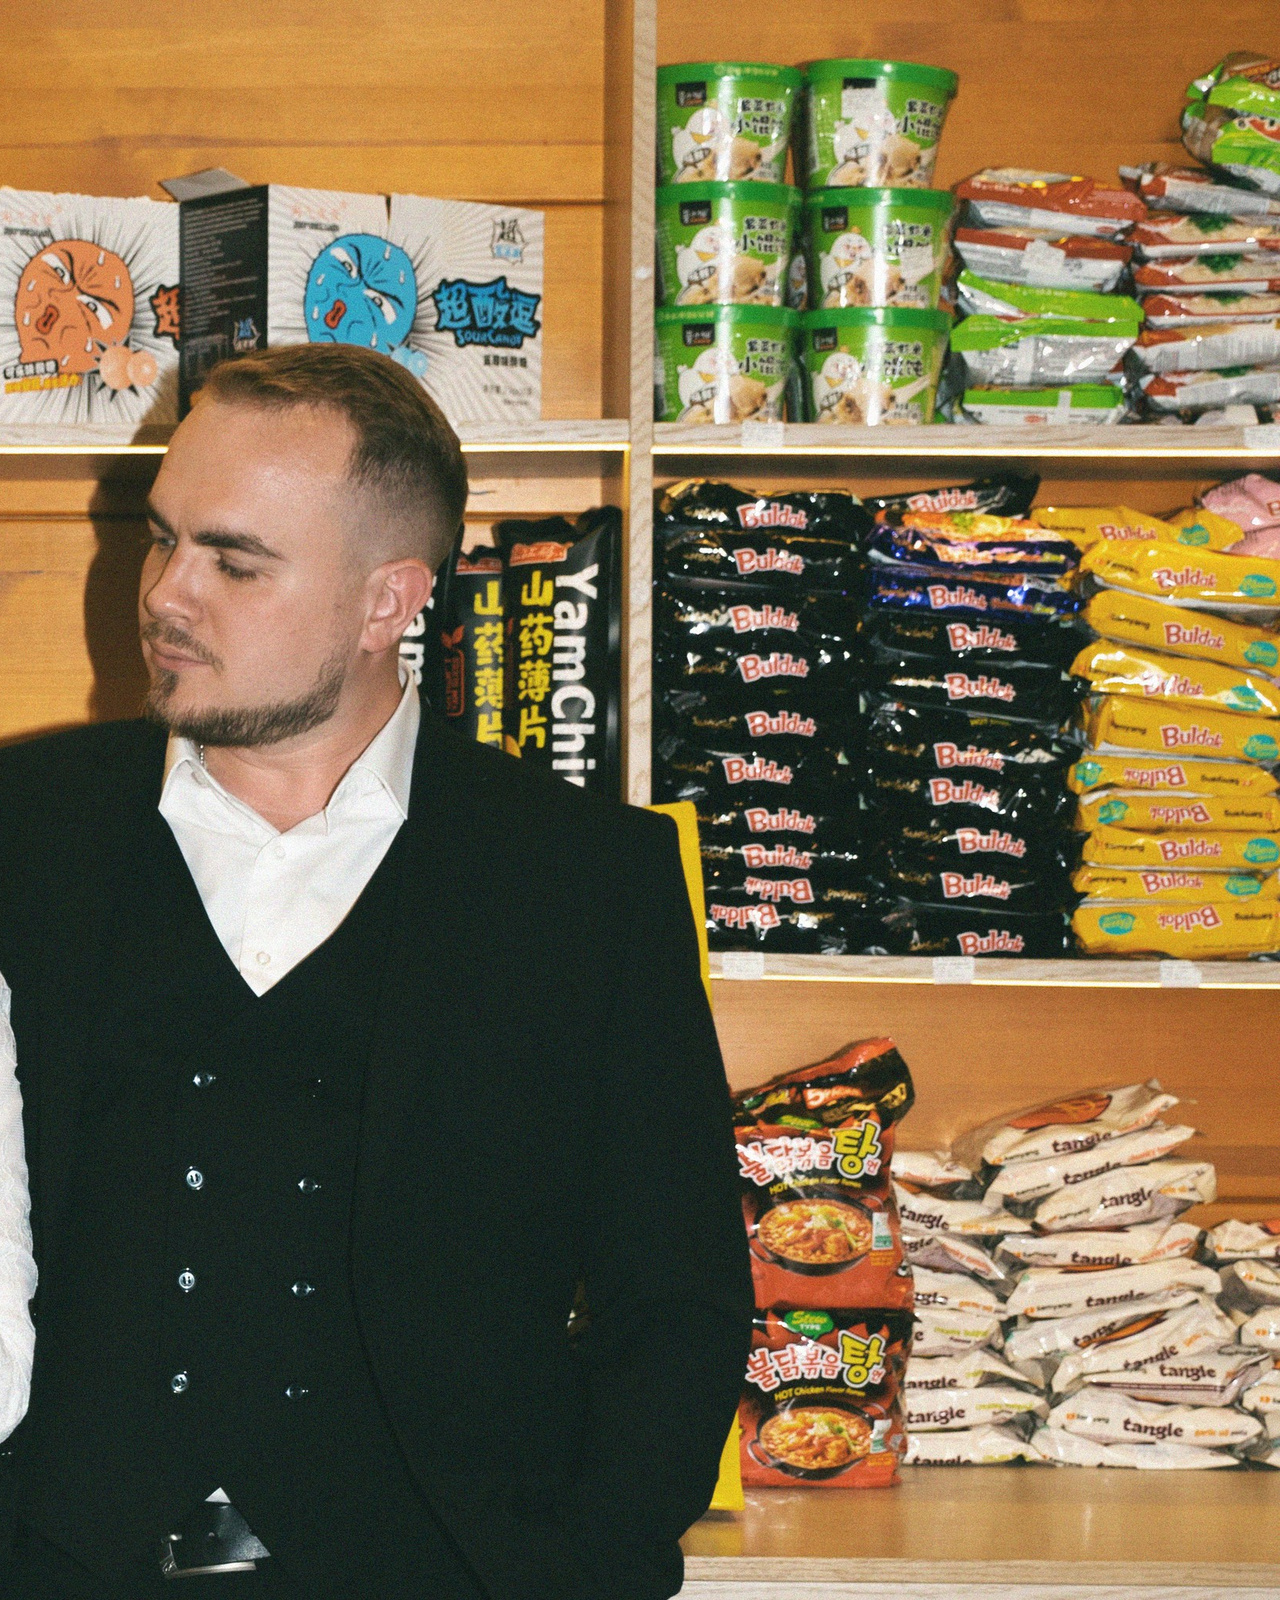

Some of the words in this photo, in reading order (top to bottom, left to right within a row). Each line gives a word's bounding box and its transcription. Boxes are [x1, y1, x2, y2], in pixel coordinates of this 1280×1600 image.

[1151, 567, 1218, 590] Buldak
[729, 604, 800, 633] Buldak
[946, 623, 1018, 651] Buldak
[1163, 623, 1226, 650] Buldak
[517, 569, 555, 749] 山药薄片
[738, 652, 809, 683] Buldak
[745, 711, 817, 737] Buldak
[1161, 724, 1223, 749] Buldak
[1123, 764, 1187, 787] Buldak
[745, 808, 816, 834] Buldak
[1149, 803, 1212, 824] Buldak
[956, 828, 1027, 858] Buldak
[1159, 838, 1223, 862] Buldak
[741, 844, 813, 870] Buldak
[745, 876, 815, 903] Buldak
[1140, 872, 1203, 894] Buldak
[1157, 904, 1222, 932] Buldak
[957, 930, 1025, 956] Buldak
[899, 1204, 950, 1232] tangle
[1159, 1363, 1217, 1382] tangle
[774, 1387, 794, 1402] HOT
[907, 1406, 966, 1425] tangle
[1122, 1417, 1184, 1440] tangle
